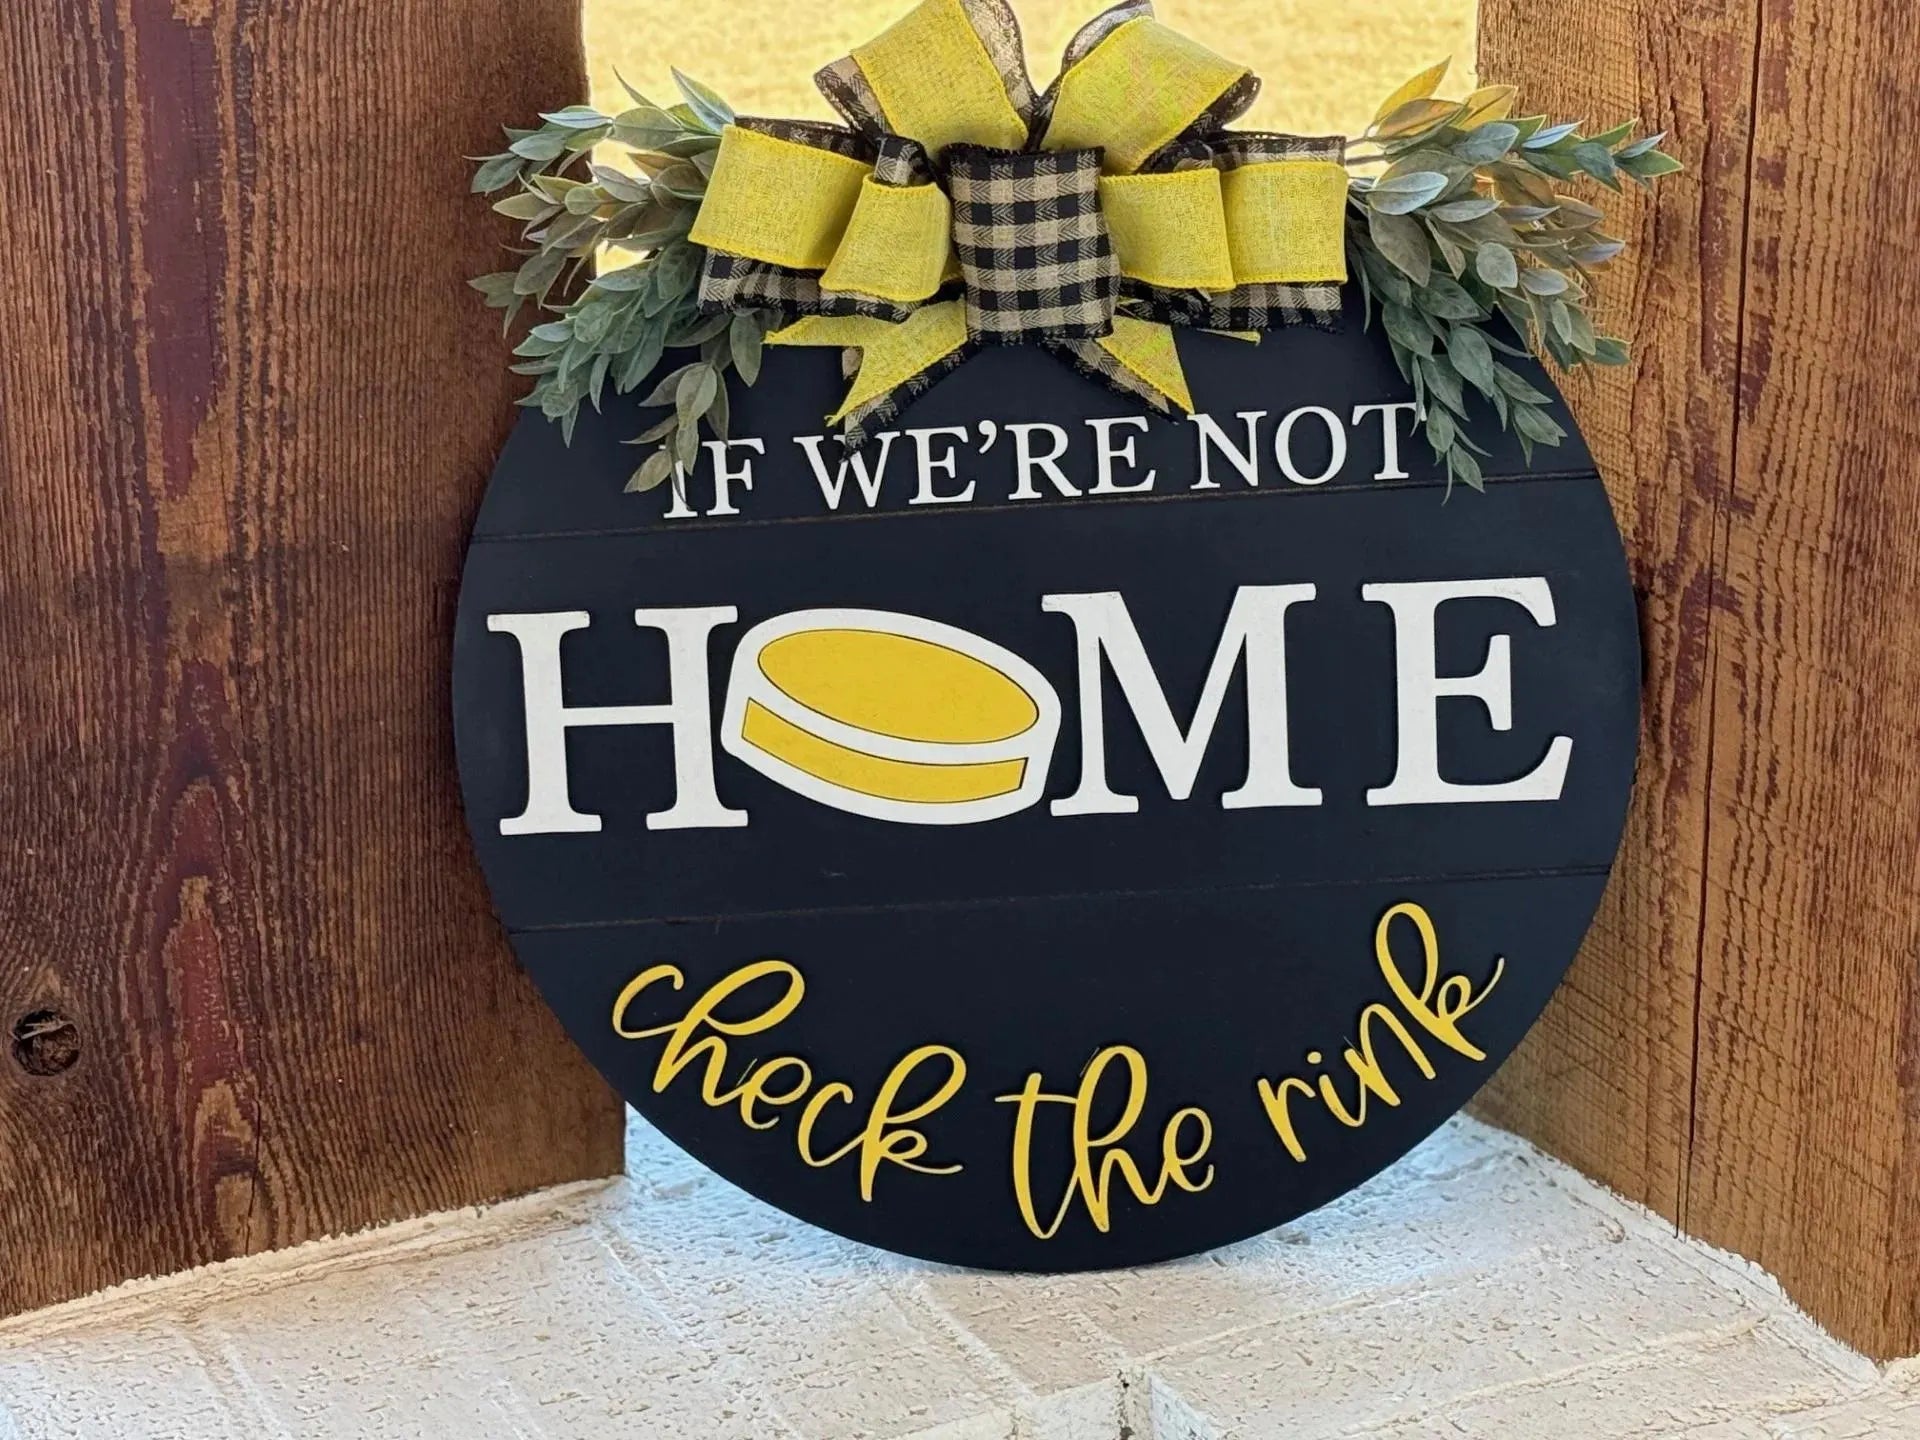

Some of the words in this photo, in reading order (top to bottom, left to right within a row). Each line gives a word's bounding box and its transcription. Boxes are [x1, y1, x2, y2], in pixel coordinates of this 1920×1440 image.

[660, 438, 766, 519] IF
[793, 414, 1156, 511] WE’RE
[1187, 402, 1427, 490] NOT
[611, 959, 965, 1201] check
[995, 1044, 1215, 1240] the
[1257, 902, 1506, 1163] rink
